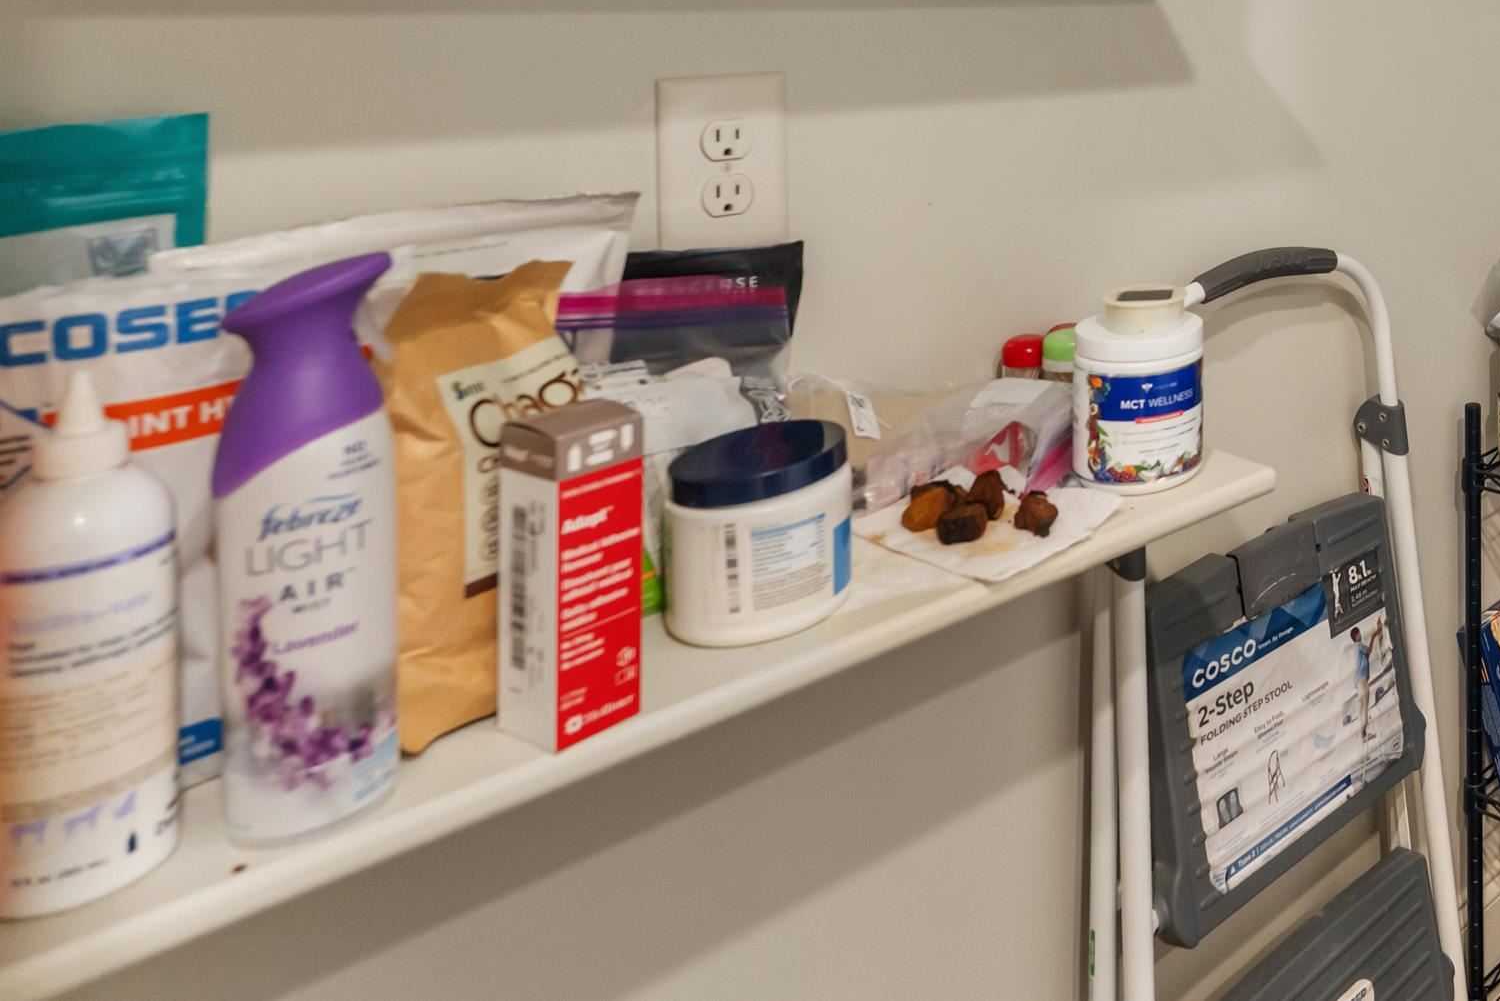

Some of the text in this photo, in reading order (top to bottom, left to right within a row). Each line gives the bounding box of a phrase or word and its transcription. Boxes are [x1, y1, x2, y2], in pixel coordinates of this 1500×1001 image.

[1120, 388, 1193, 410] MCT WELLNESS
[128, 404, 195, 438] INT
[245, 519, 372, 576] LIGHT
[280, 572, 344, 601] AIR
[273, 620, 360, 655] Lavender
[1192, 639, 1256, 688] COSCO
[1198, 681, 1254, 727] 2-Step
[1201, 715, 1242, 746] FOLDING
[1243, 699, 1263, 719] STEP
[1264, 680, 1293, 704] STOOL
